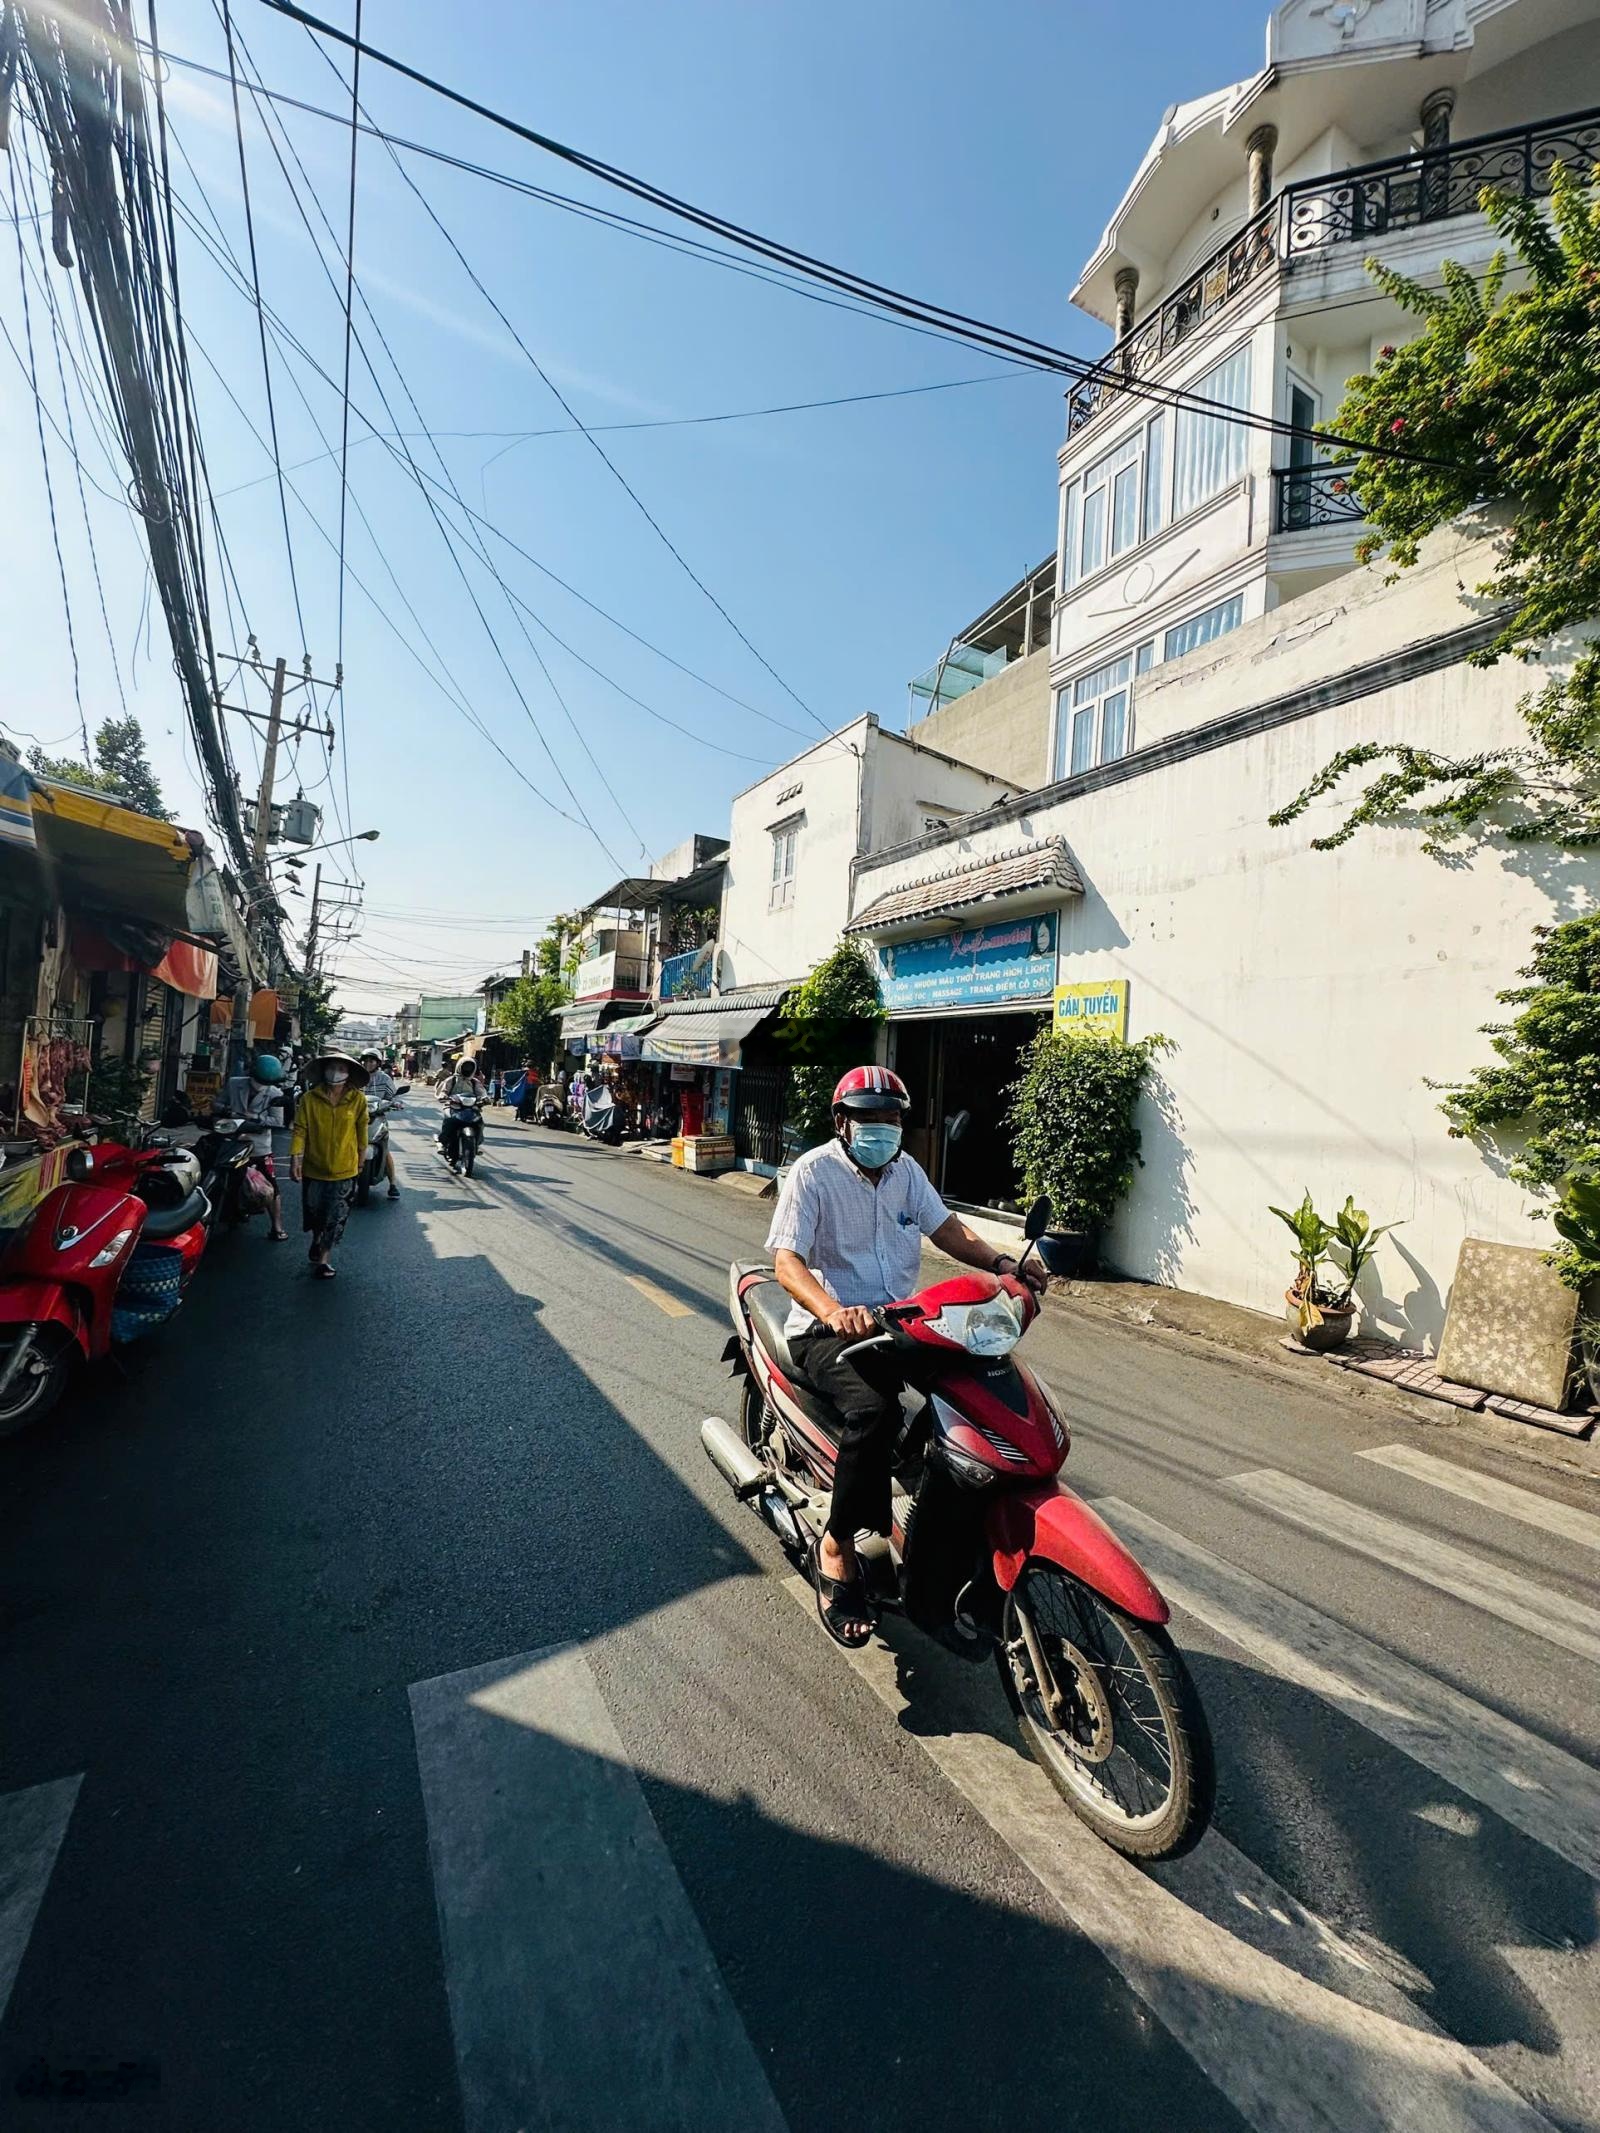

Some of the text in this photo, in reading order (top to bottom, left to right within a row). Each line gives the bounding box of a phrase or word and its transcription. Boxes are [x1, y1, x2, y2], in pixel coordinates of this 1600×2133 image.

[975, 969, 1001, 980] TRANG
[1003, 967, 1023, 978] HIGH
[1026, 964, 1051, 974] LIGHT
[970, 984, 994, 994] TRANG
